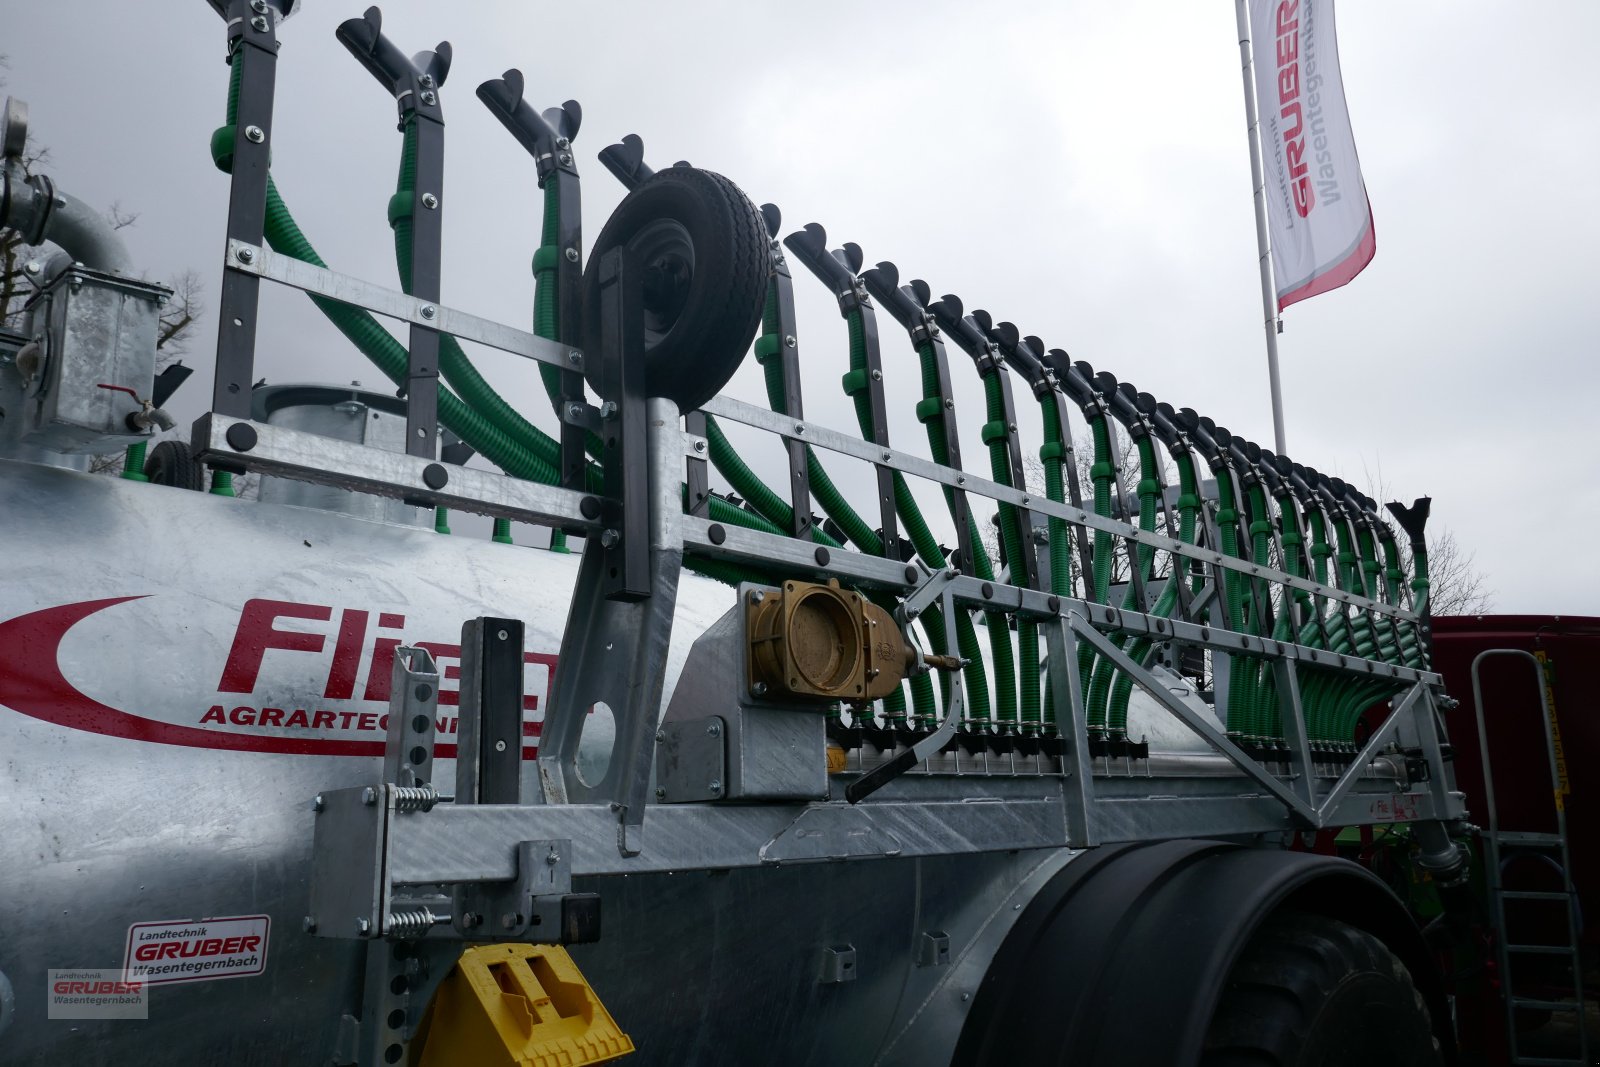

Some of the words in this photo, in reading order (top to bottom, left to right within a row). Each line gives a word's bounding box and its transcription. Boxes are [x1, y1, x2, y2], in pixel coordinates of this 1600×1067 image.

[1276, 0, 1316, 219] GRUBER
[1270, 117, 1293, 230] Landtechnik
[139, 928, 207, 940] Landtechnik
[135, 936, 261, 961] GRUBER
[133, 955, 258, 976] Wasentegernbach
